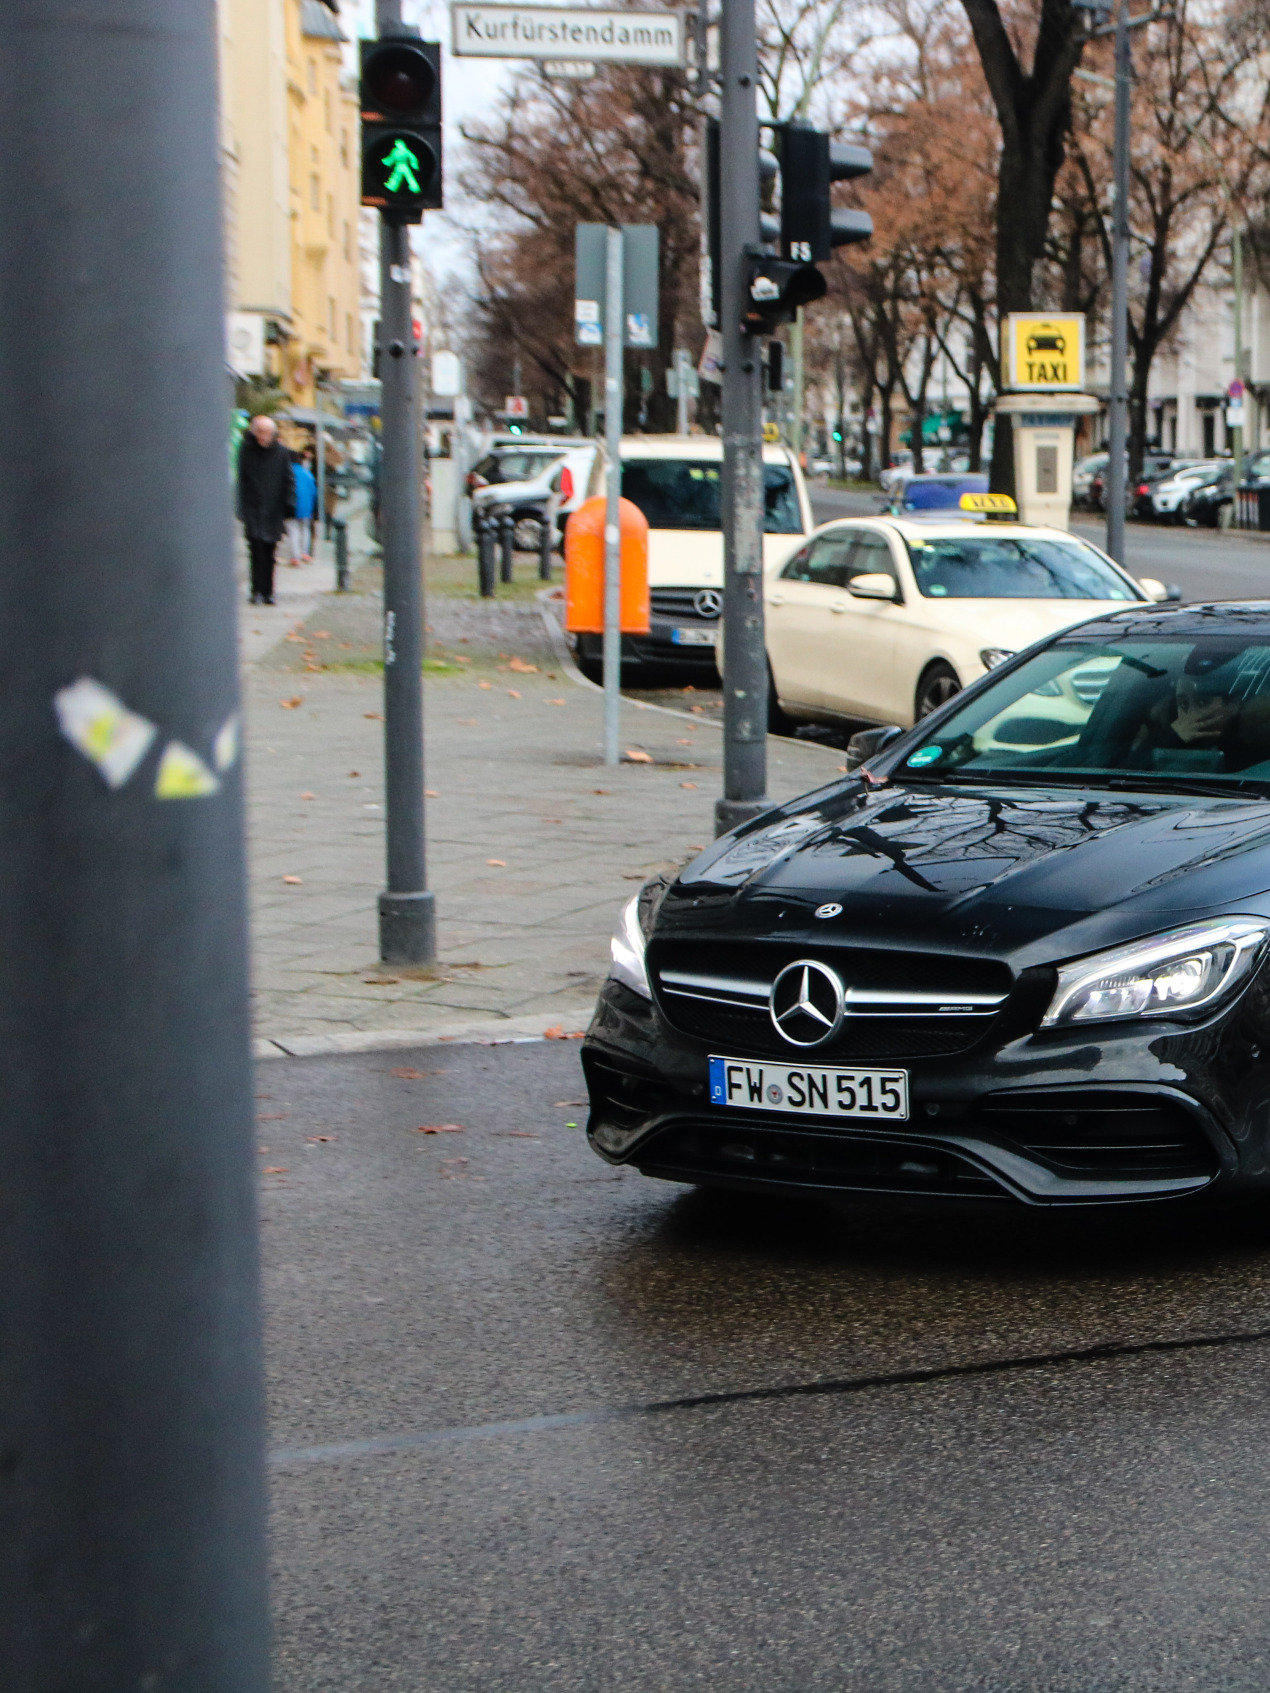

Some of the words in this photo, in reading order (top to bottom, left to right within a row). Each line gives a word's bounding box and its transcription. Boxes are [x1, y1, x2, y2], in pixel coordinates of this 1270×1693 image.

[466, 13, 672, 46] Kurfürstendamm
[1026, 361, 1068, 383] TAXI
[727, 1066, 763, 1103] FW
[787, 1071, 829, 1109] SN
[836, 1074, 901, 1113] 515
